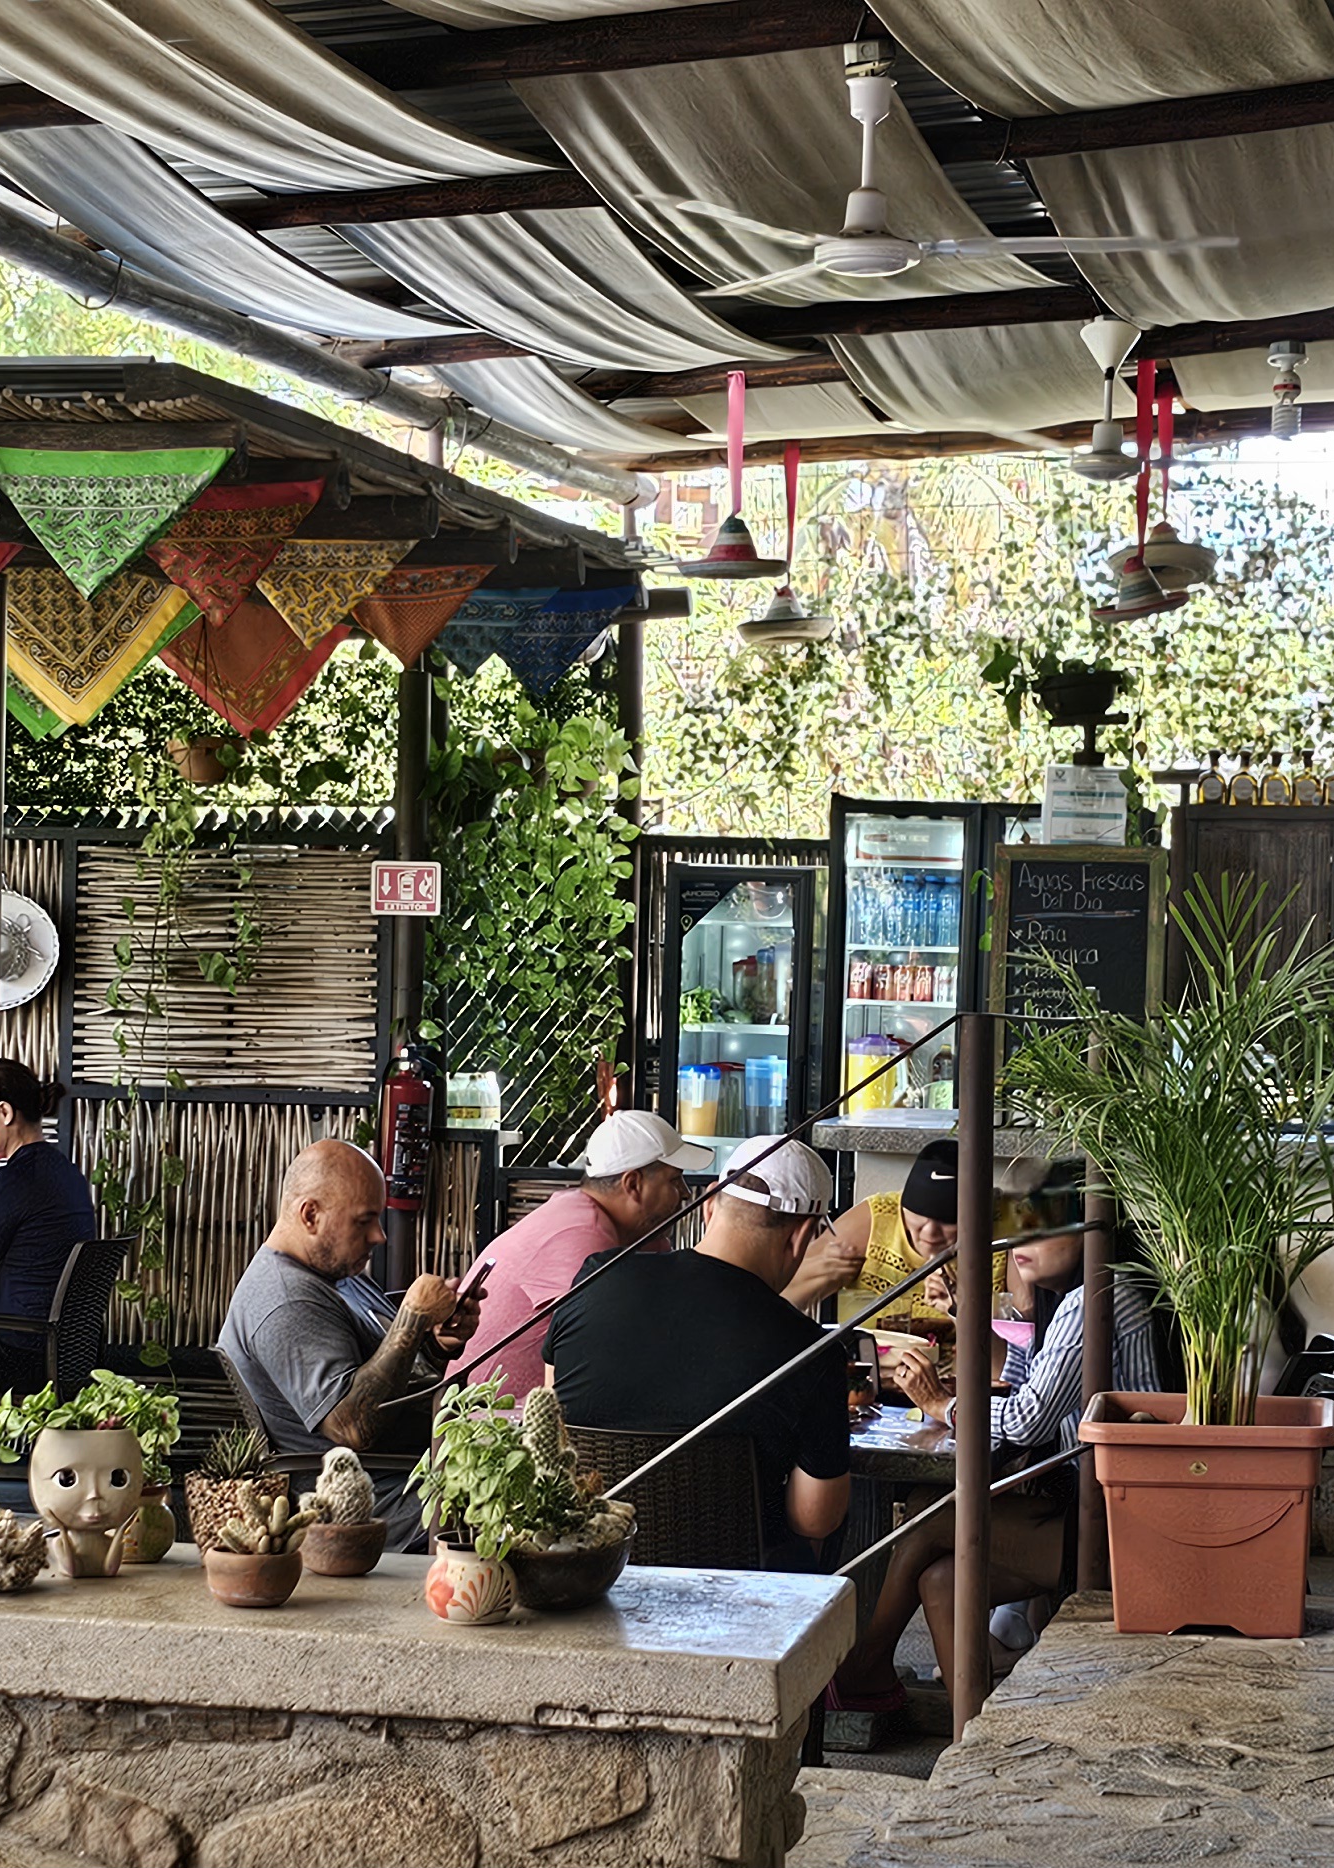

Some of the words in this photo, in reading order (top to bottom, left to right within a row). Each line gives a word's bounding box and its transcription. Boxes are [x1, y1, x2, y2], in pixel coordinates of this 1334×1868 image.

[1018, 863, 1073, 897] Aguas
[1082, 864, 1145, 892] Frescas
[1042, 893, 1063, 910] Del
